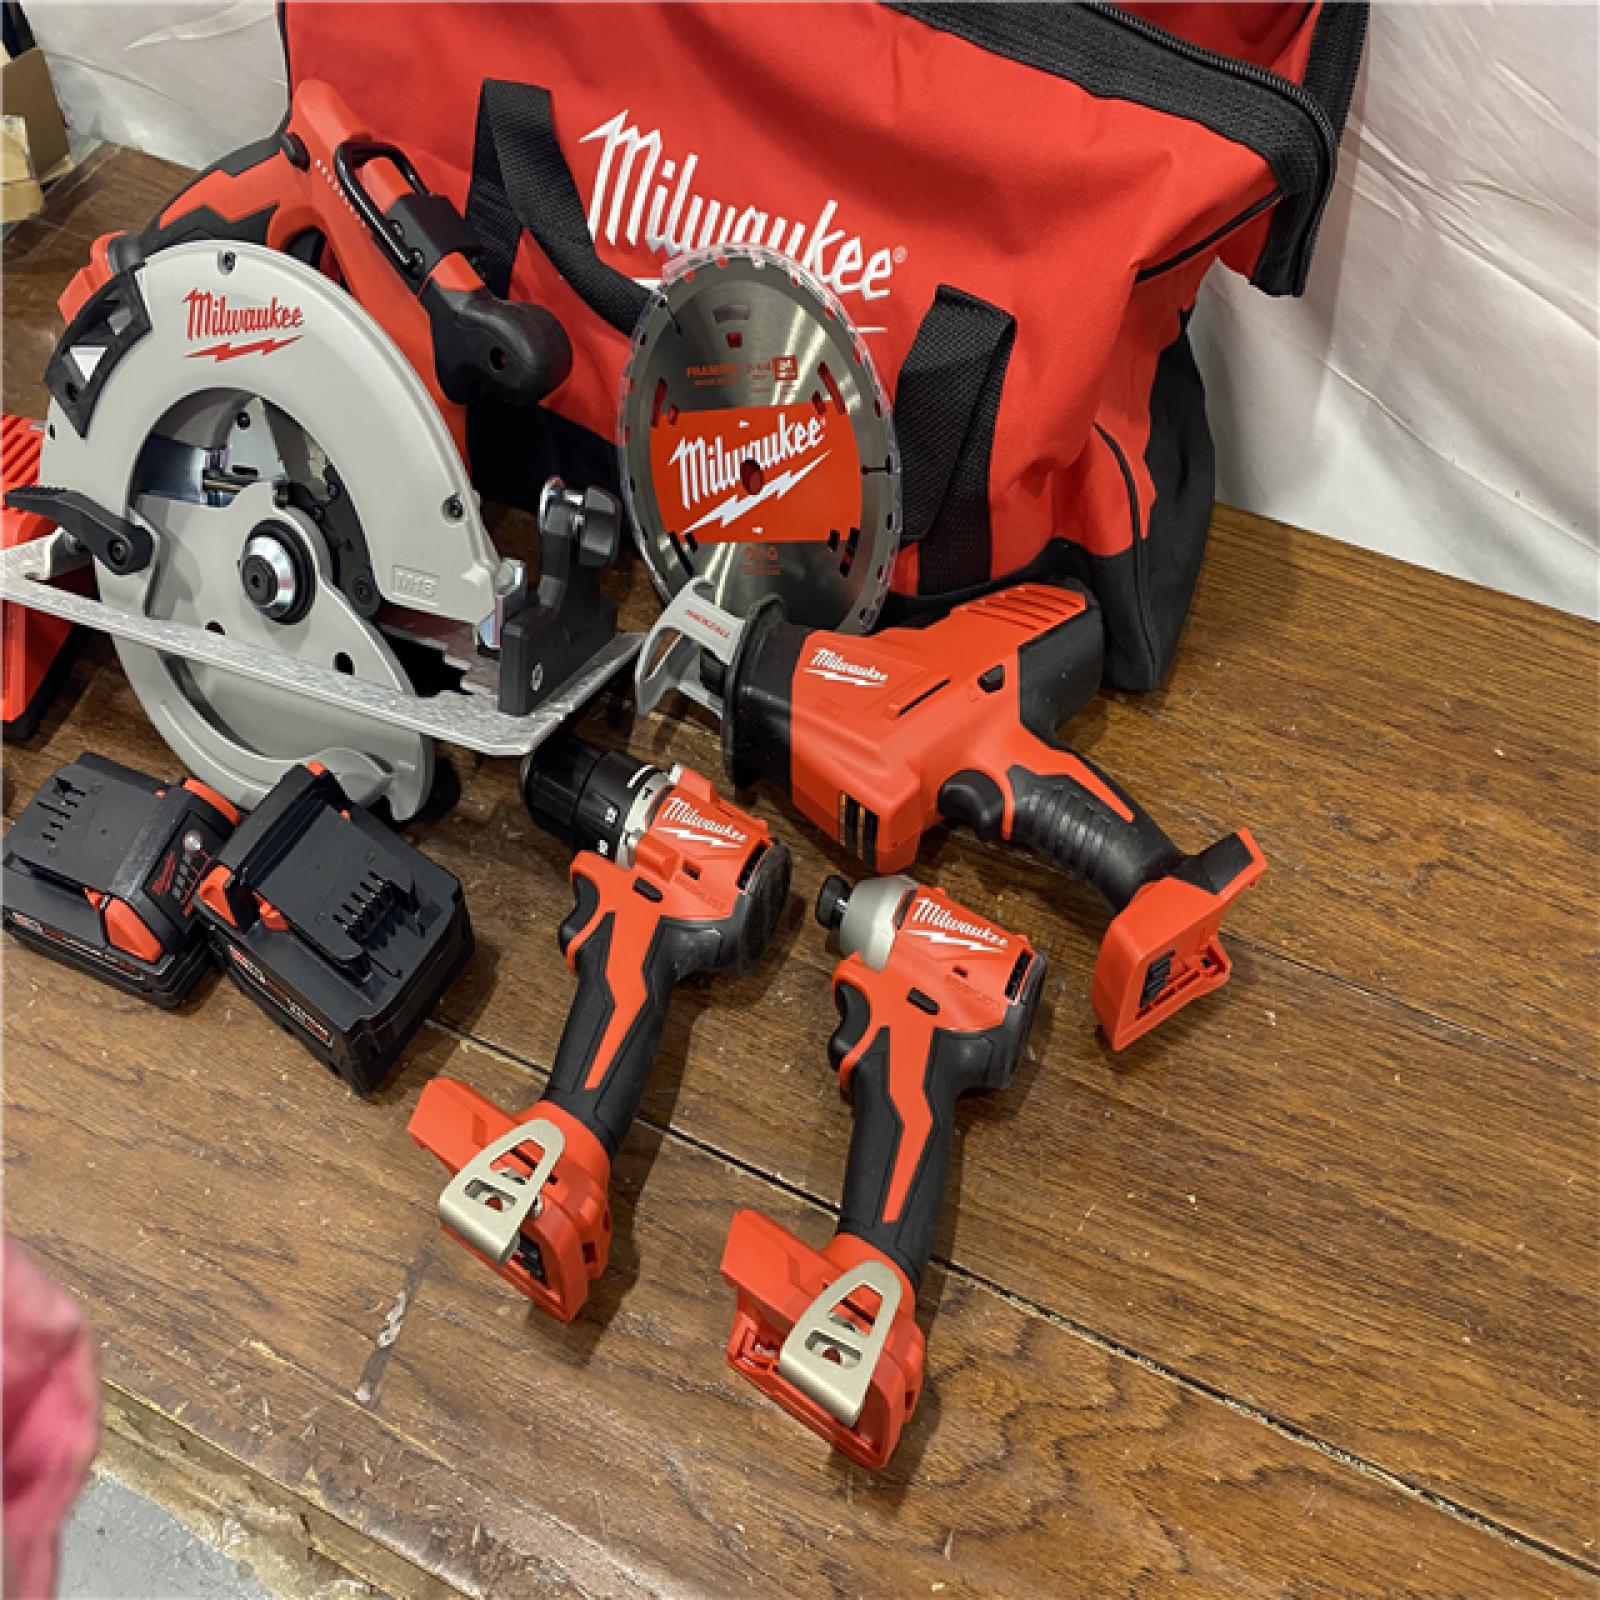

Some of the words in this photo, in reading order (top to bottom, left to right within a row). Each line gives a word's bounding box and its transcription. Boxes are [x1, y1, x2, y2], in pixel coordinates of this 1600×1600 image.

[579, 109, 892, 301] Milwaukee
[182, 287, 305, 341] Milwaukee
[667, 412, 826, 510] Milwaukee
[809, 647, 889, 682] Milwaukee
[661, 797, 747, 843] Milwaukee
[911, 898, 1009, 948] Milwaukee
